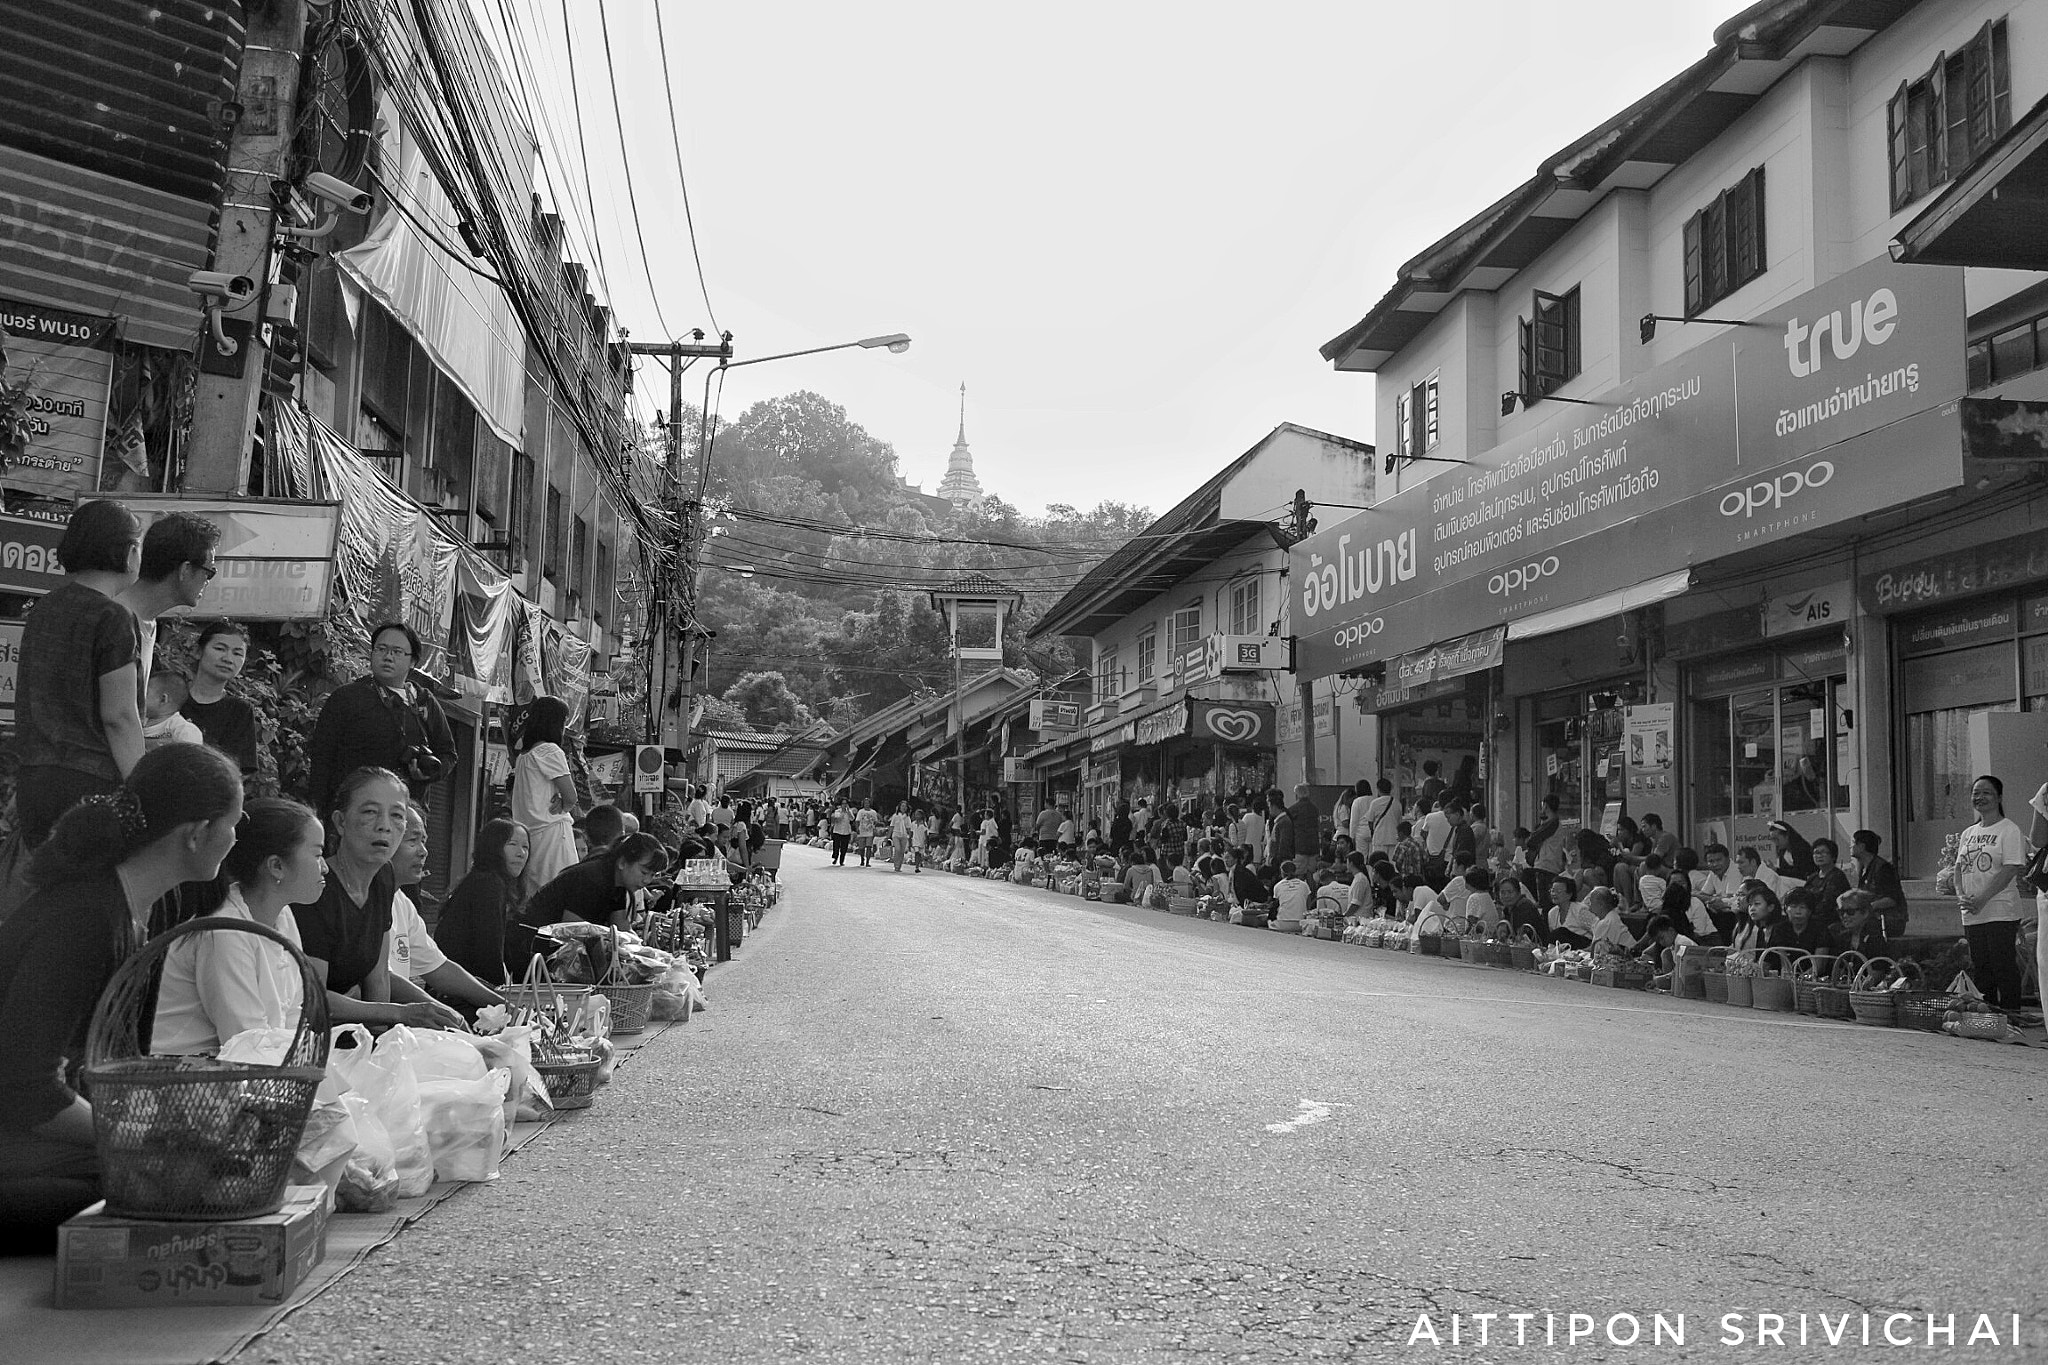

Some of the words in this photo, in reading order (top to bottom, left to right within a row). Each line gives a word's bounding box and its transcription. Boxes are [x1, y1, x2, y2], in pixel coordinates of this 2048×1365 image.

[39, 318, 91, 340] WU10
[1784, 288, 1898, 378] true
[56, 399, 83, 416] นาที
[1775, 363, 1919, 437] ตัวแทนจำหน่ายทรู
[1433, 485, 1464, 514] จำหน่าย
[1468, 432, 1569, 498] โทรศัพท์มือถือมือหนึ่ง,
[1434, 486, 1536, 542] เติมเงินออนไลน์ทุกระบบ,
[1541, 439, 1627, 501] อุปกรณ์โทรศัพท์
[1719, 461, 1835, 518] oppo
[1737, 510, 1817, 542] SMARTPHONE
[1434, 518, 1523, 575] อุปกรณ์คอมพิวเตอร์
[1303, 527, 1417, 617] อ้อโมบาย
[1488, 556, 1560, 596] oppo
[1498, 594, 1549, 615] SMARTPHONE
[1806, 601, 1831, 622] AIS
[1334, 617, 1384, 649] oppo
[1241, 648, 1257, 659] 3G
